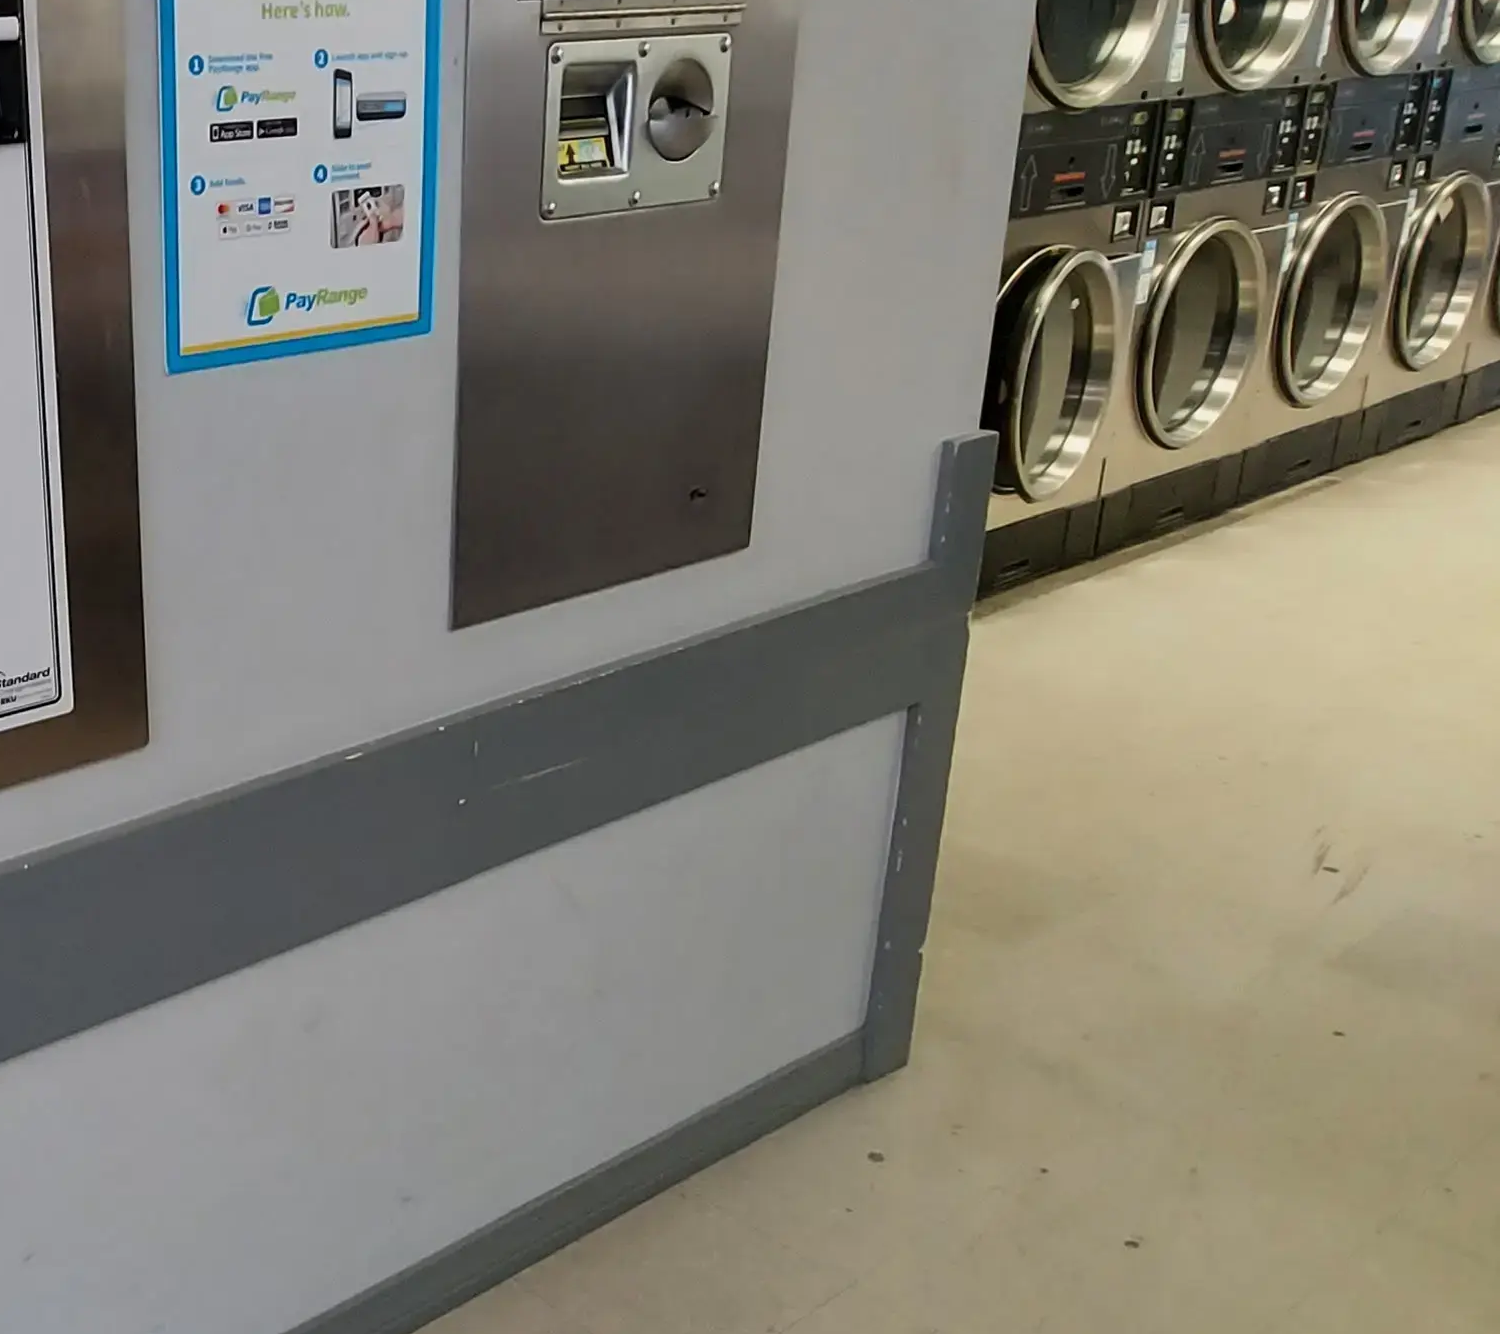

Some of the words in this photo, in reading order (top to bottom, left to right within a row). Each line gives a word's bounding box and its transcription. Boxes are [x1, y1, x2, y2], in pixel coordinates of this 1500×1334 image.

[261, 1, 310, 19] Here's
[314, 0, 350, 17] how.
[284, 287, 368, 311] PayRange
